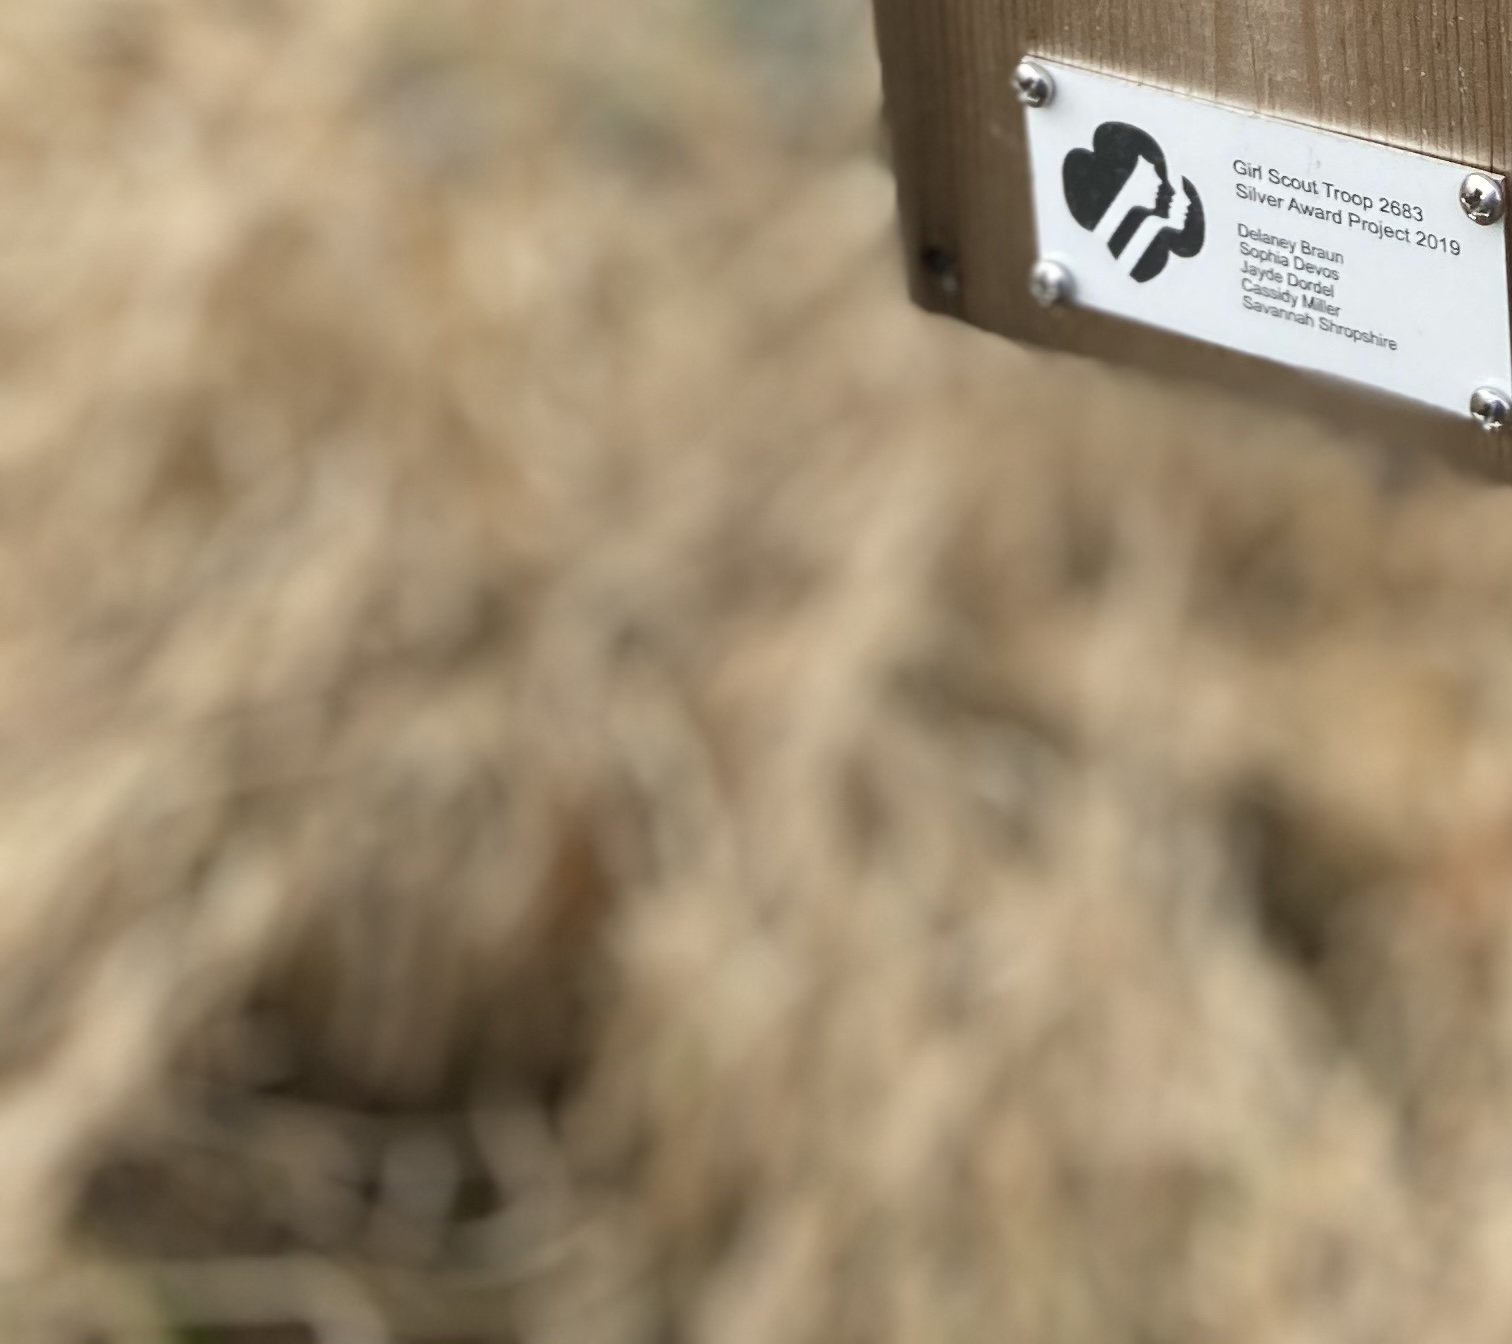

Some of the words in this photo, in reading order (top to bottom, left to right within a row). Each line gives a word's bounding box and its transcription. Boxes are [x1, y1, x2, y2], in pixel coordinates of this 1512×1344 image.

[1233, 160, 1263, 180] Girl
[1268, 169, 1319, 195] Scout
[1322, 182, 1373, 210] Troop
[1379, 198, 1423, 221] 2683
[1236, 184, 1284, 208] Silver
[1288, 198, 1342, 224] Award
[1349, 213, 1410, 243] Project
[1416, 231, 1460, 255] 2019
[1238, 223, 1296, 254] Delaney
[1301, 240, 1344, 264] Braun
[1240, 242, 1288, 266] Sophia
[1294, 256, 1339, 280] Devos
[1241, 261, 1284, 284] Jayde
[1288, 274, 1334, 297] Dordel
[1242, 278, 1298, 308] Cassidy
[1302, 295, 1342, 317] Miller
[1243, 295, 1314, 327] Savannah
[1319, 317, 1397, 350] Shropshire
